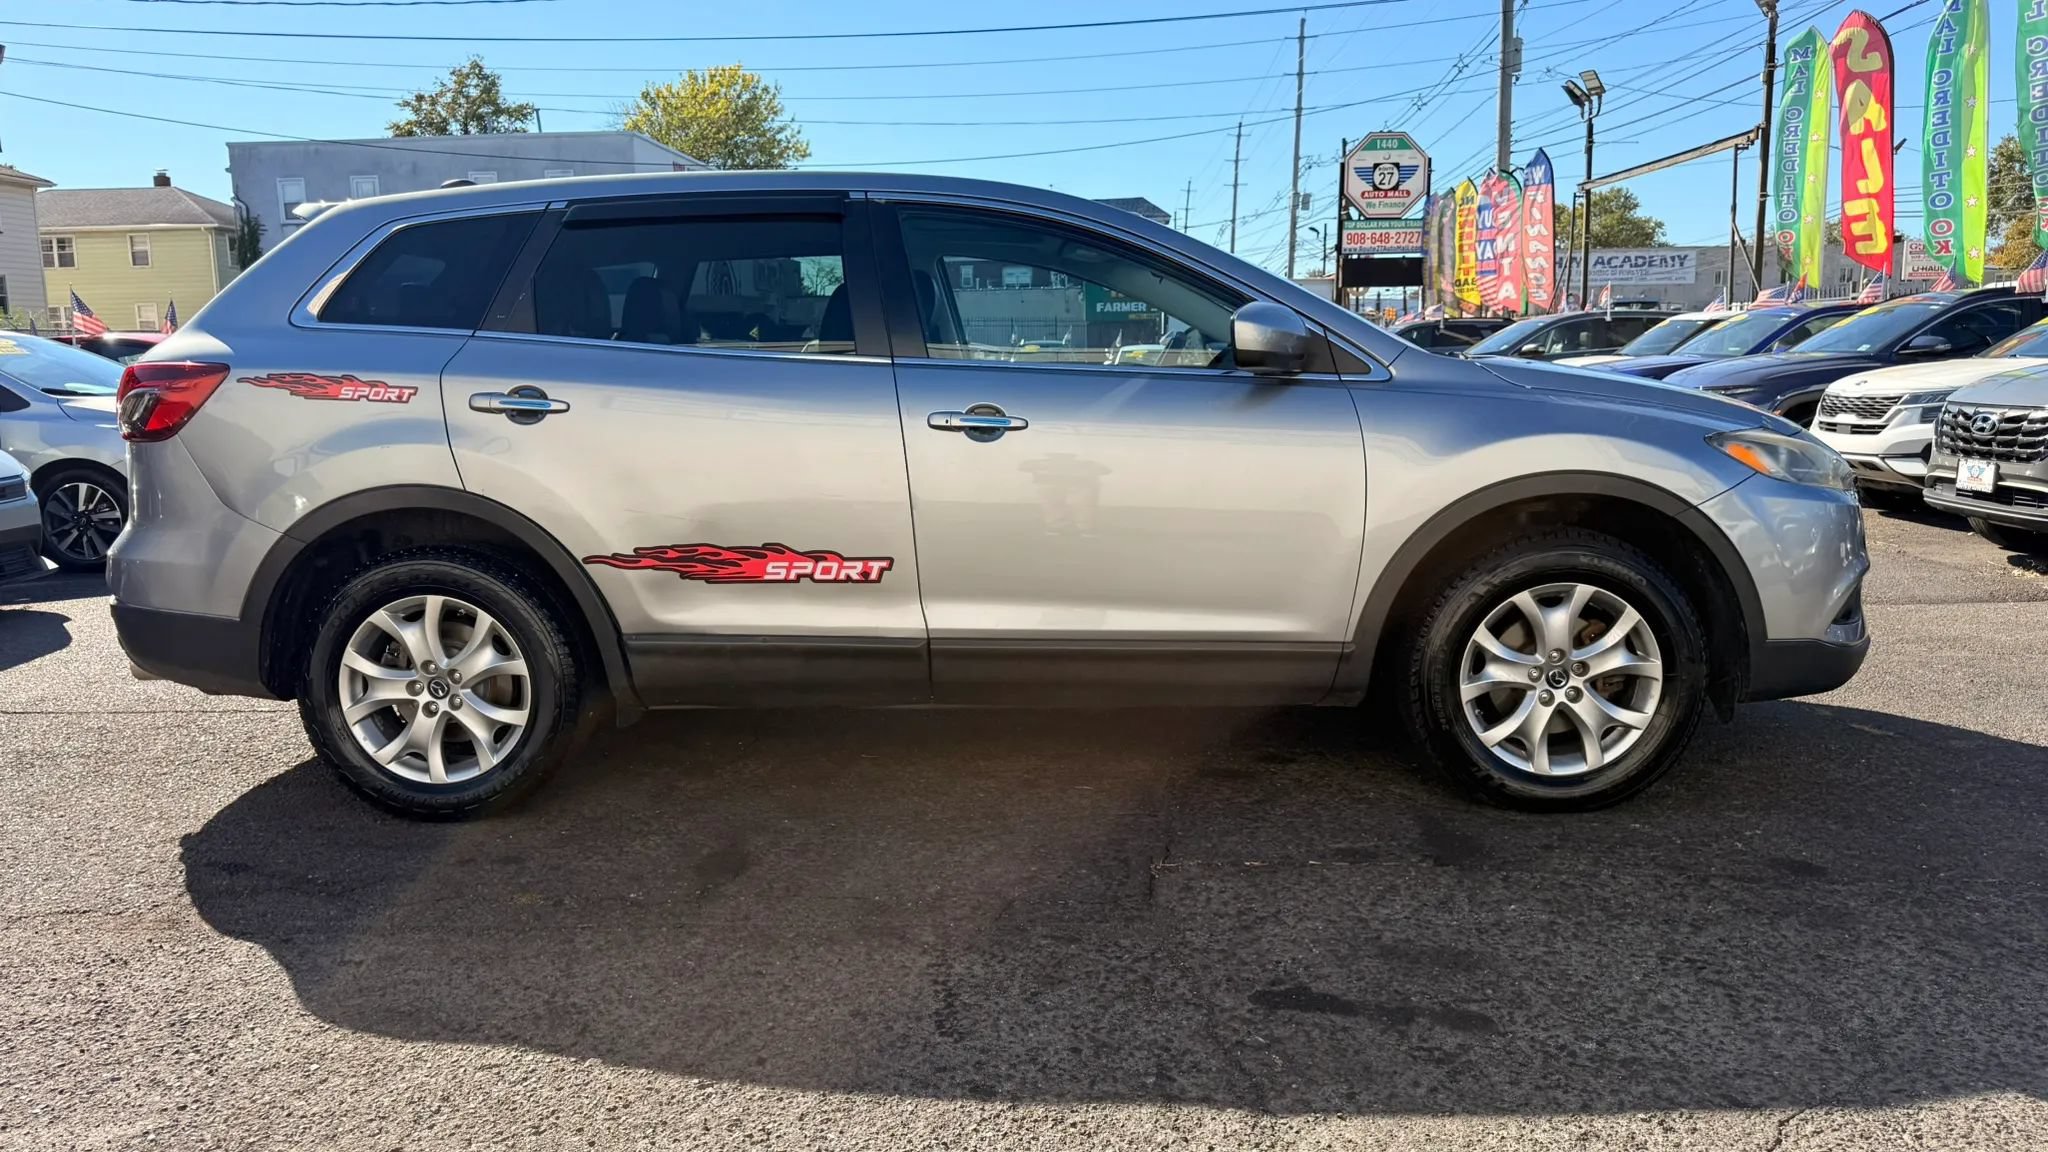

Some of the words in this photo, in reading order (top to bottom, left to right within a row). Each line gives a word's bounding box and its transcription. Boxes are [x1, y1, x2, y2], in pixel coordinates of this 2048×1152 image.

[1376, 139, 1398, 149] 1440
[1377, 172, 1395, 186] 27
[1363, 190, 1385, 198] AUTO
[1386, 190, 1408, 198] MALL
[1365, 201, 1377, 209] We
[1378, 200, 1407, 209] Finance
[1344, 221, 1356, 229] TOP
[1346, 231, 1421, 245] 908-648-2727
[1592, 254, 1688, 268] ACADEMY
[1096, 302, 1147, 312] FARMER
[338, 387, 416, 401] SPORT
[763, 560, 891, 581] SPORT
